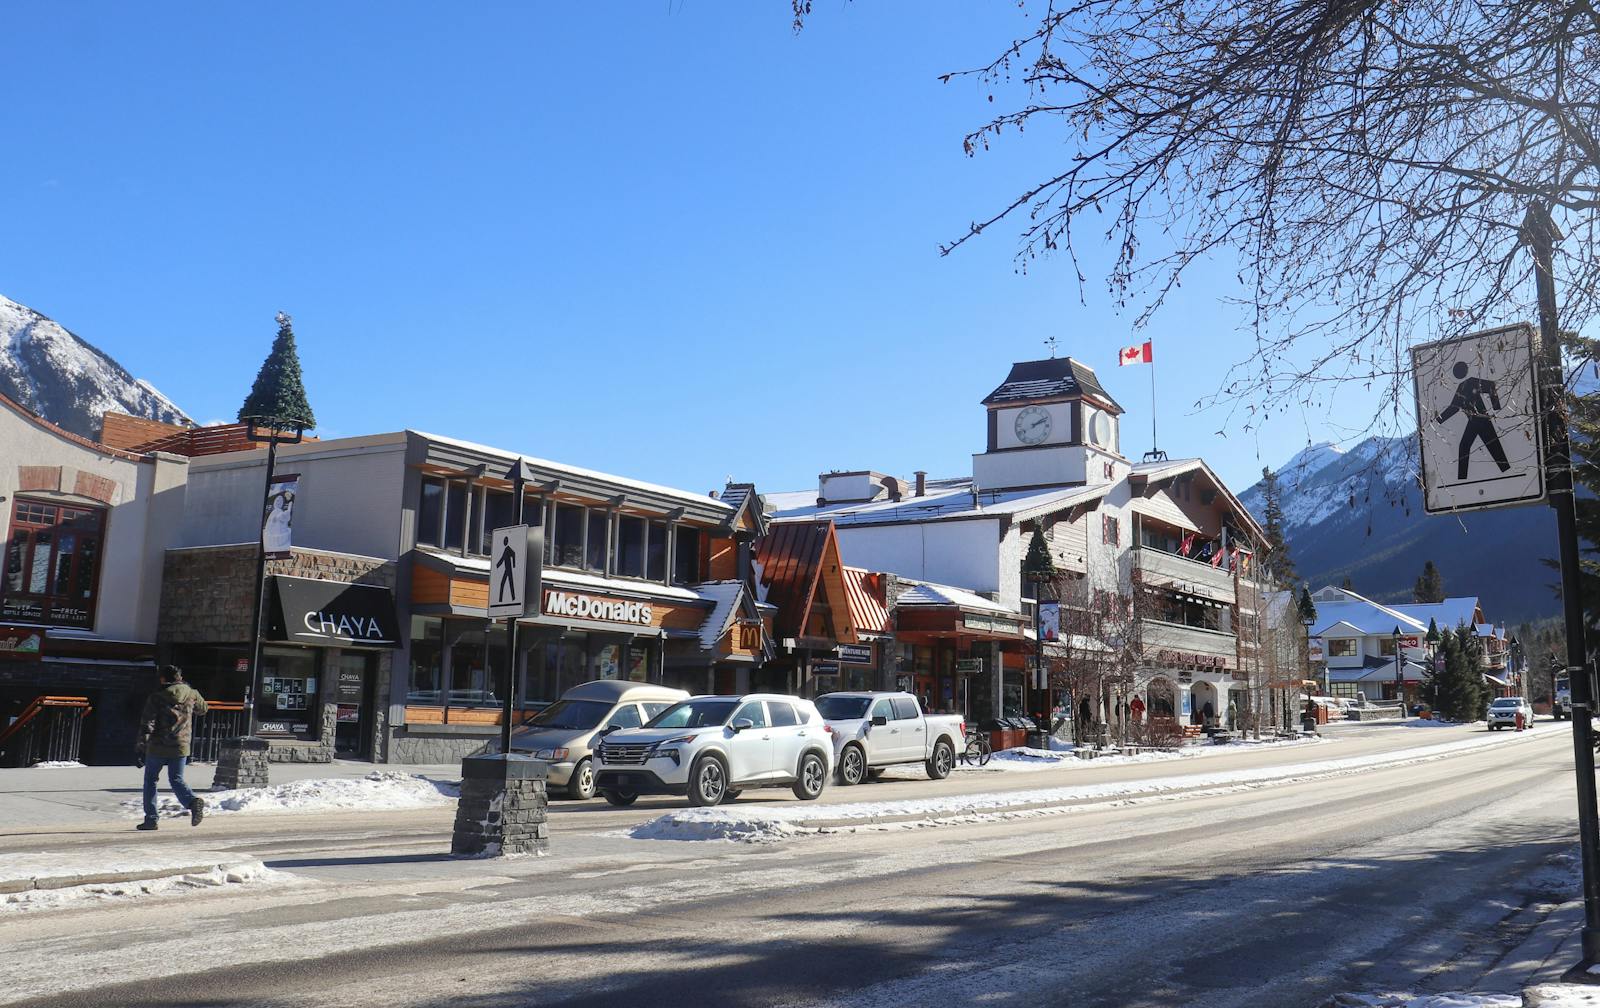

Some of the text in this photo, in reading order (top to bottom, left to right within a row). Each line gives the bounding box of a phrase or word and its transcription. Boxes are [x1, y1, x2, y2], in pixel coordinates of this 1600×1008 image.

[547, 591, 652, 624] McDonald's
[303, 611, 384, 638] CHAYA
[340, 673, 359, 681] CHAYA
